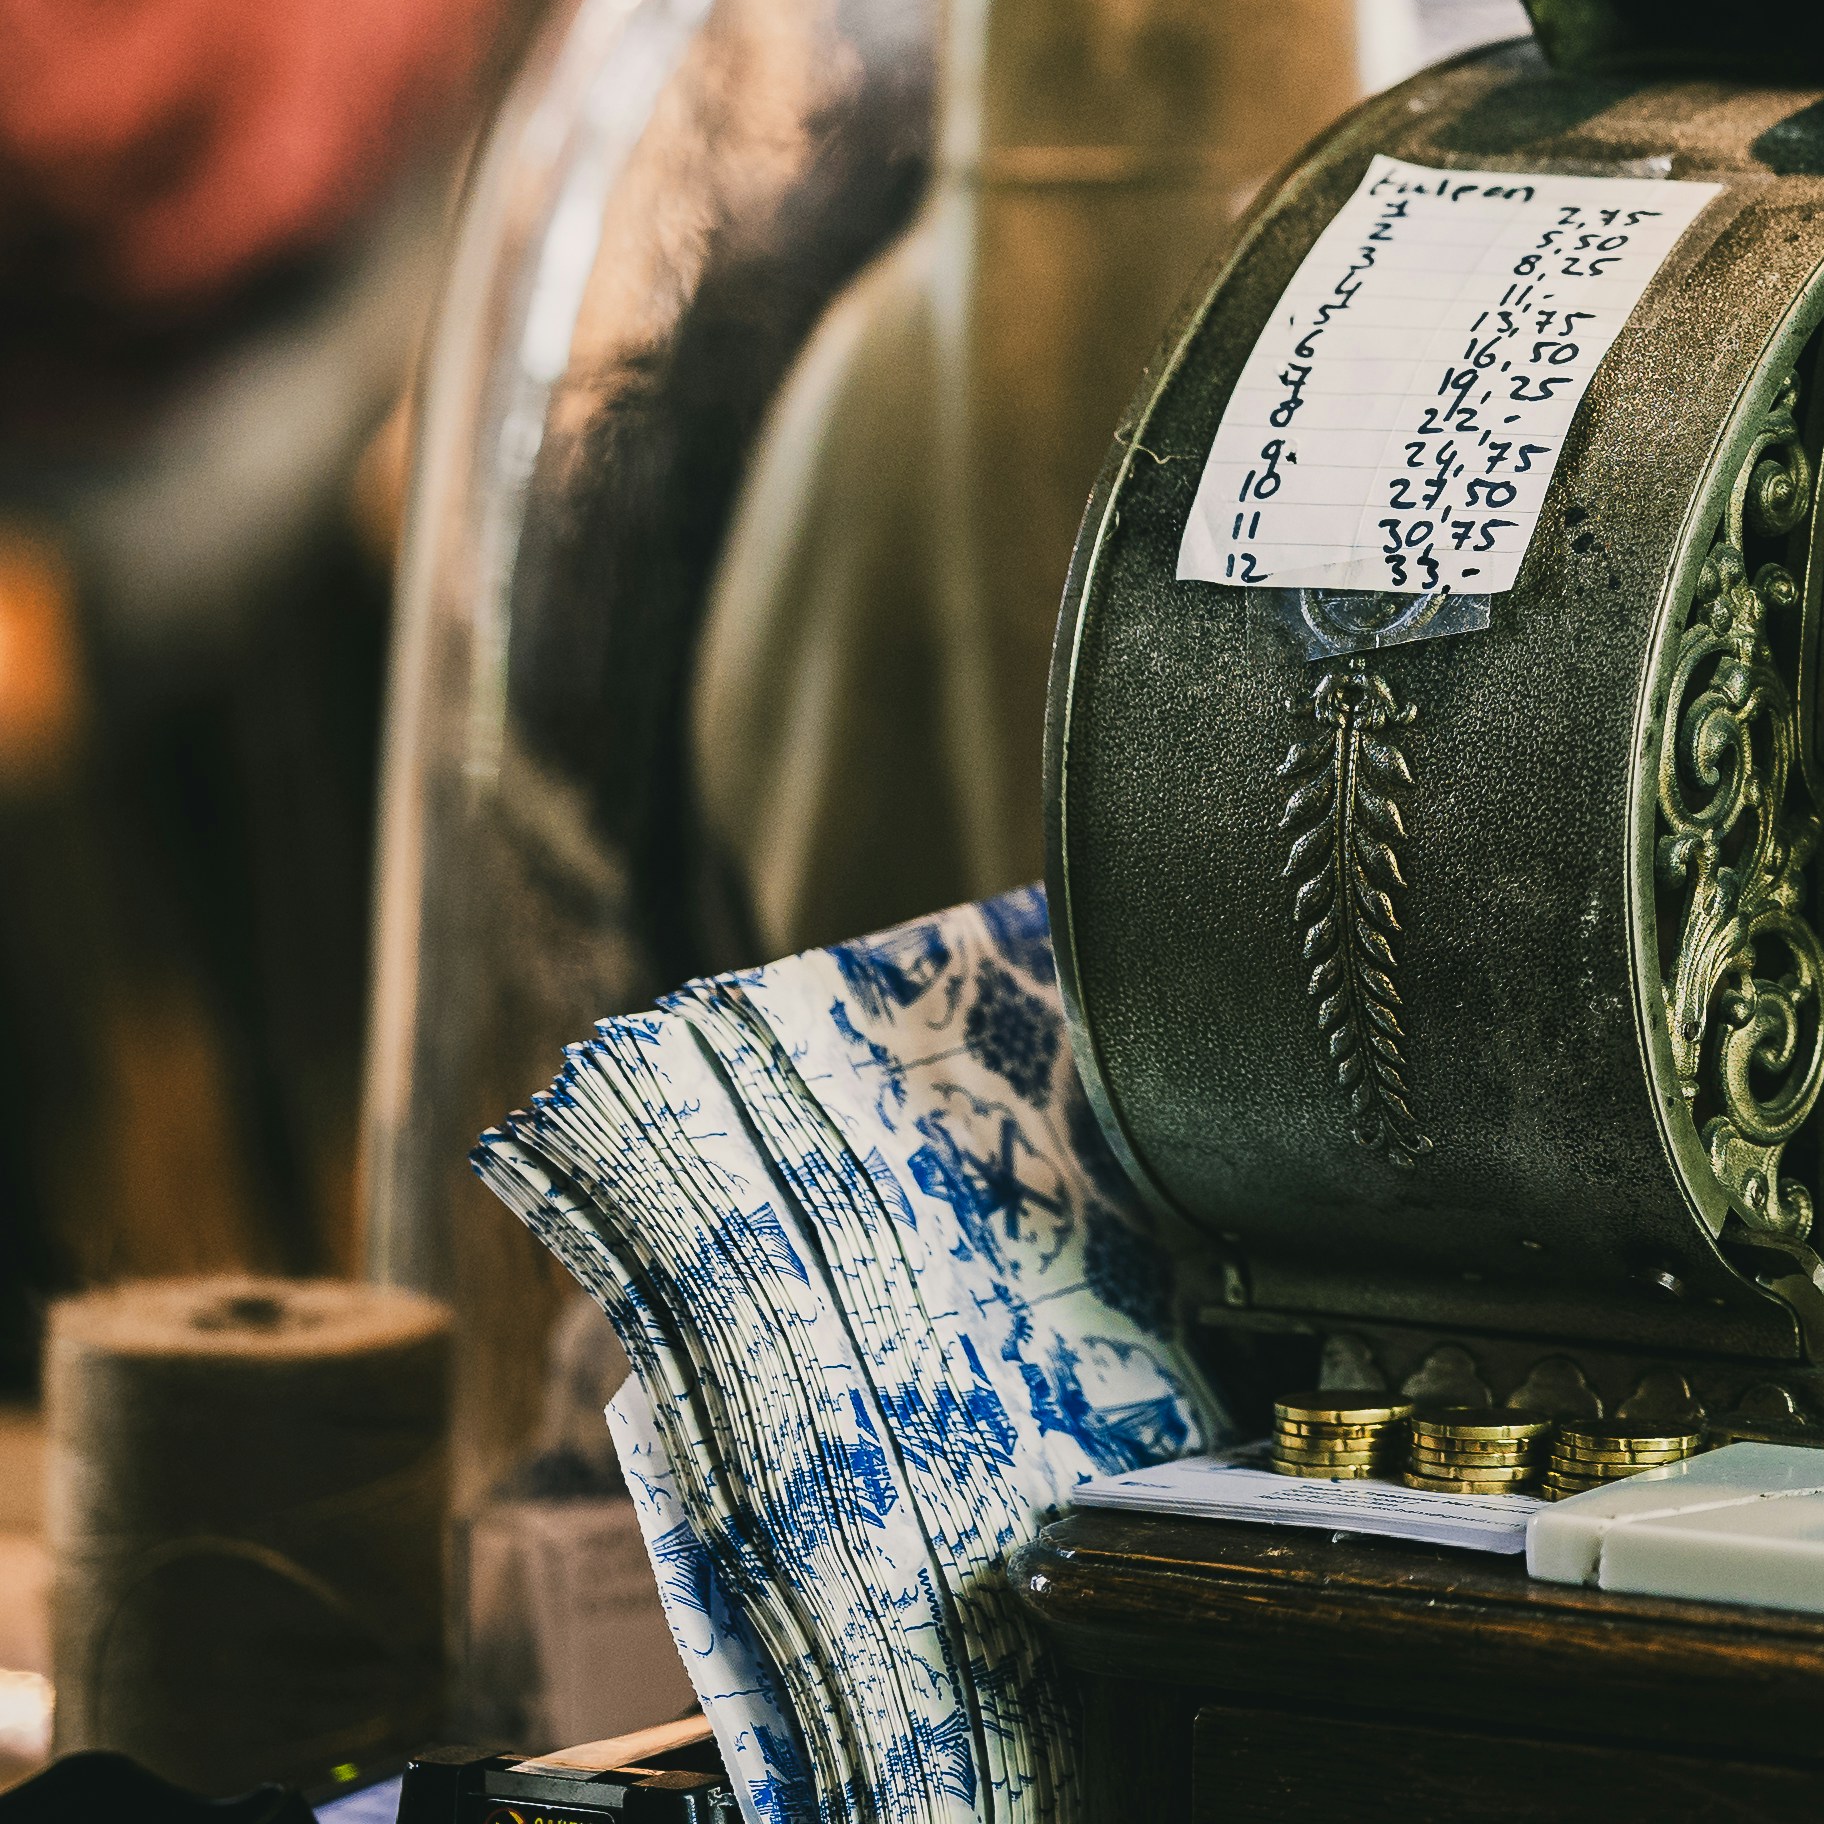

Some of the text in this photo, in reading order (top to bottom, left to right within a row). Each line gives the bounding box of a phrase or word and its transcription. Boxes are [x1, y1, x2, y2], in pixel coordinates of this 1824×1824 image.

[1368, 223, 1628, 255] 2 5,50
[1513, 255, 1622, 281] 8,25
[1470, 311, 1596, 337] 13,75
[1294, 329, 1579, 373] 6 16,50
[1270, 398, 1304, 427] 8
[1438, 367, 1574, 422] 19,25
[1261, 439, 1552, 479] 9 24,75
[1238, 470, 1518, 523] 10 27,50
[1232, 511, 1519, 558] 11 30,75
[1226, 553, 1274, 584] 12
